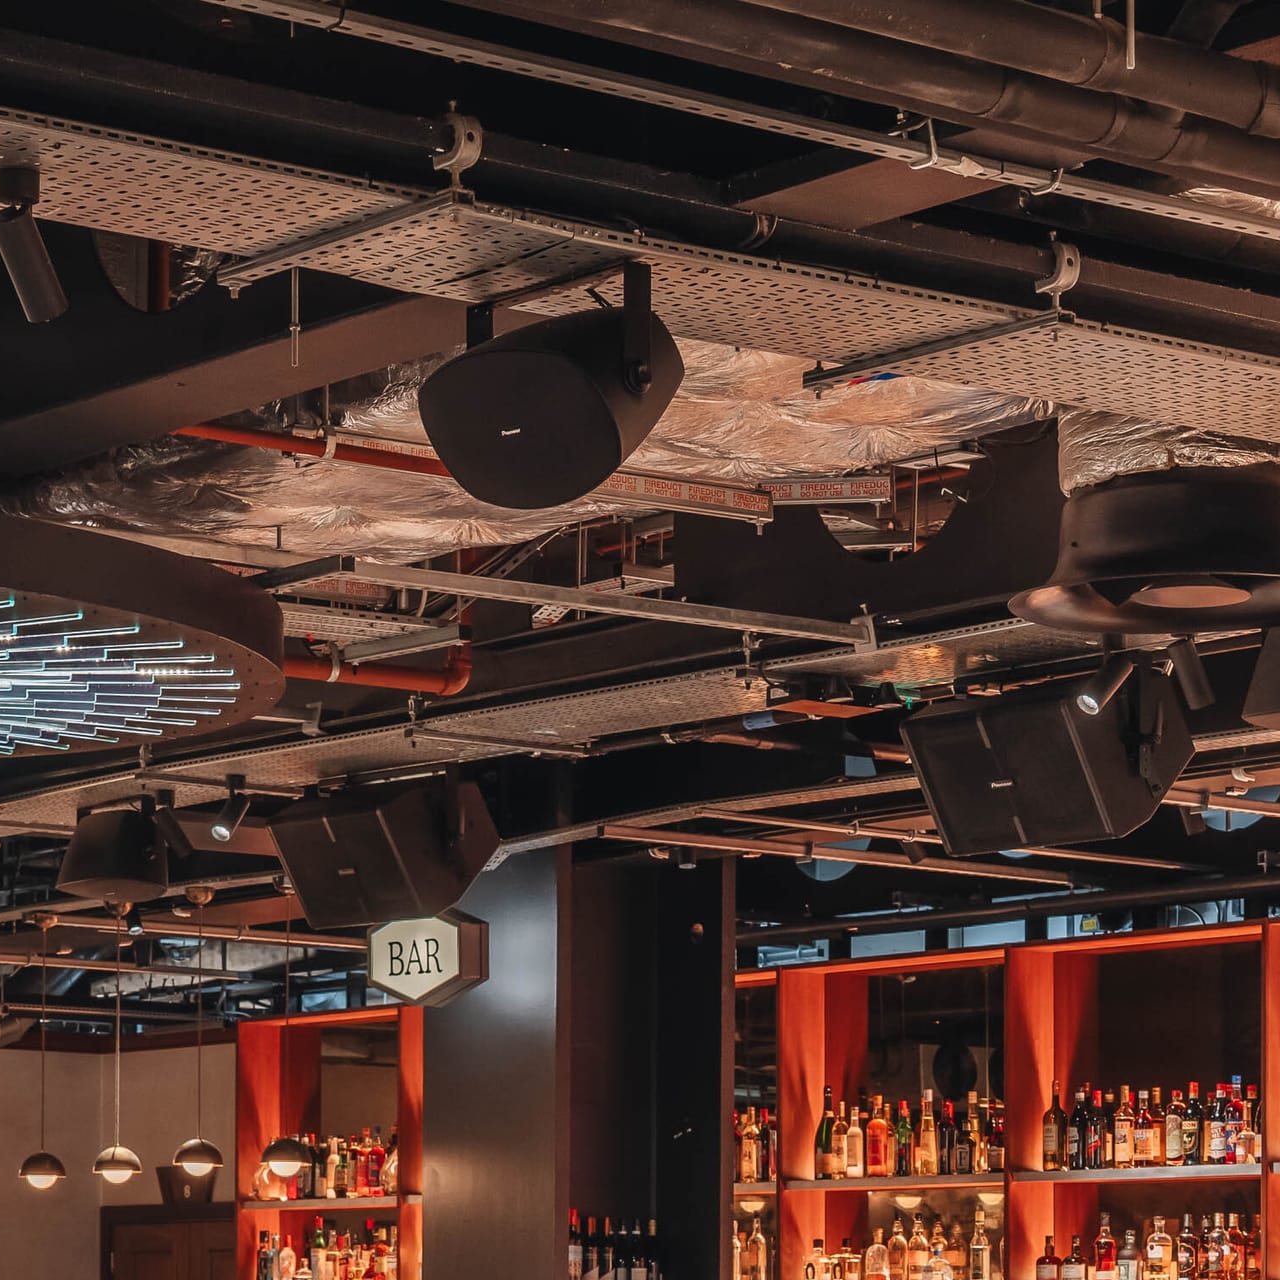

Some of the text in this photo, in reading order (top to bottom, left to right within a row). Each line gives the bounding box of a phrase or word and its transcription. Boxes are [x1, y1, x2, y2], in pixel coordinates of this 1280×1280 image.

[644, 479, 683, 491] FIREDUCT
[688, 485, 727, 498] FIREDUCT
[732, 492, 769, 505] FIREDUC
[800, 482, 845, 491] FIREDUCT
[850, 480, 889, 489] FIREDUC
[388, 938, 443, 977] BAR
